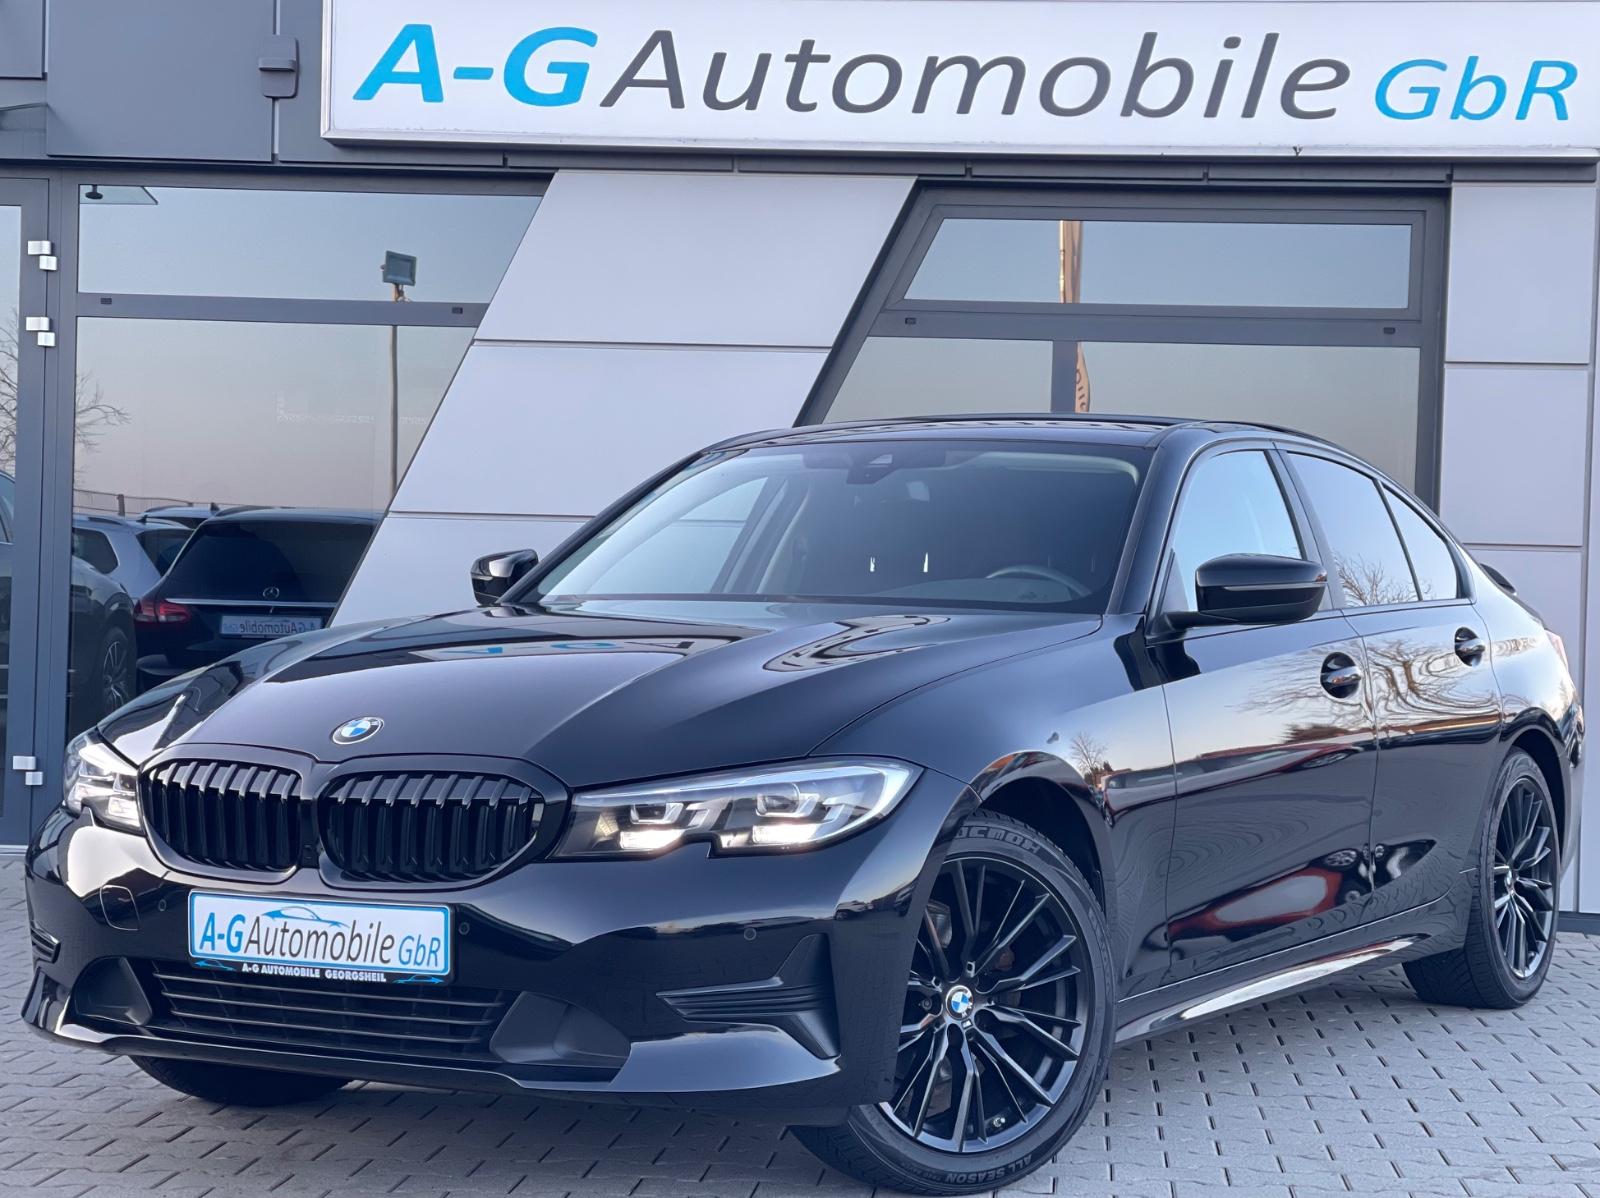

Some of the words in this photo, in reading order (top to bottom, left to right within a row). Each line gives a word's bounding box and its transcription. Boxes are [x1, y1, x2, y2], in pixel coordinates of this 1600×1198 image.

[1375, 55, 1578, 121] GbR
[398, 934, 442, 968] GbR
[242, 963, 260, 974] A-G
[261, 964, 321, 979] AUTOMOBILE
[325, 969, 387, 983] GEORGSHEIL
[1008, 1153, 1032, 1173] ALL
[945, 1167, 1006, 1184] SEASON
